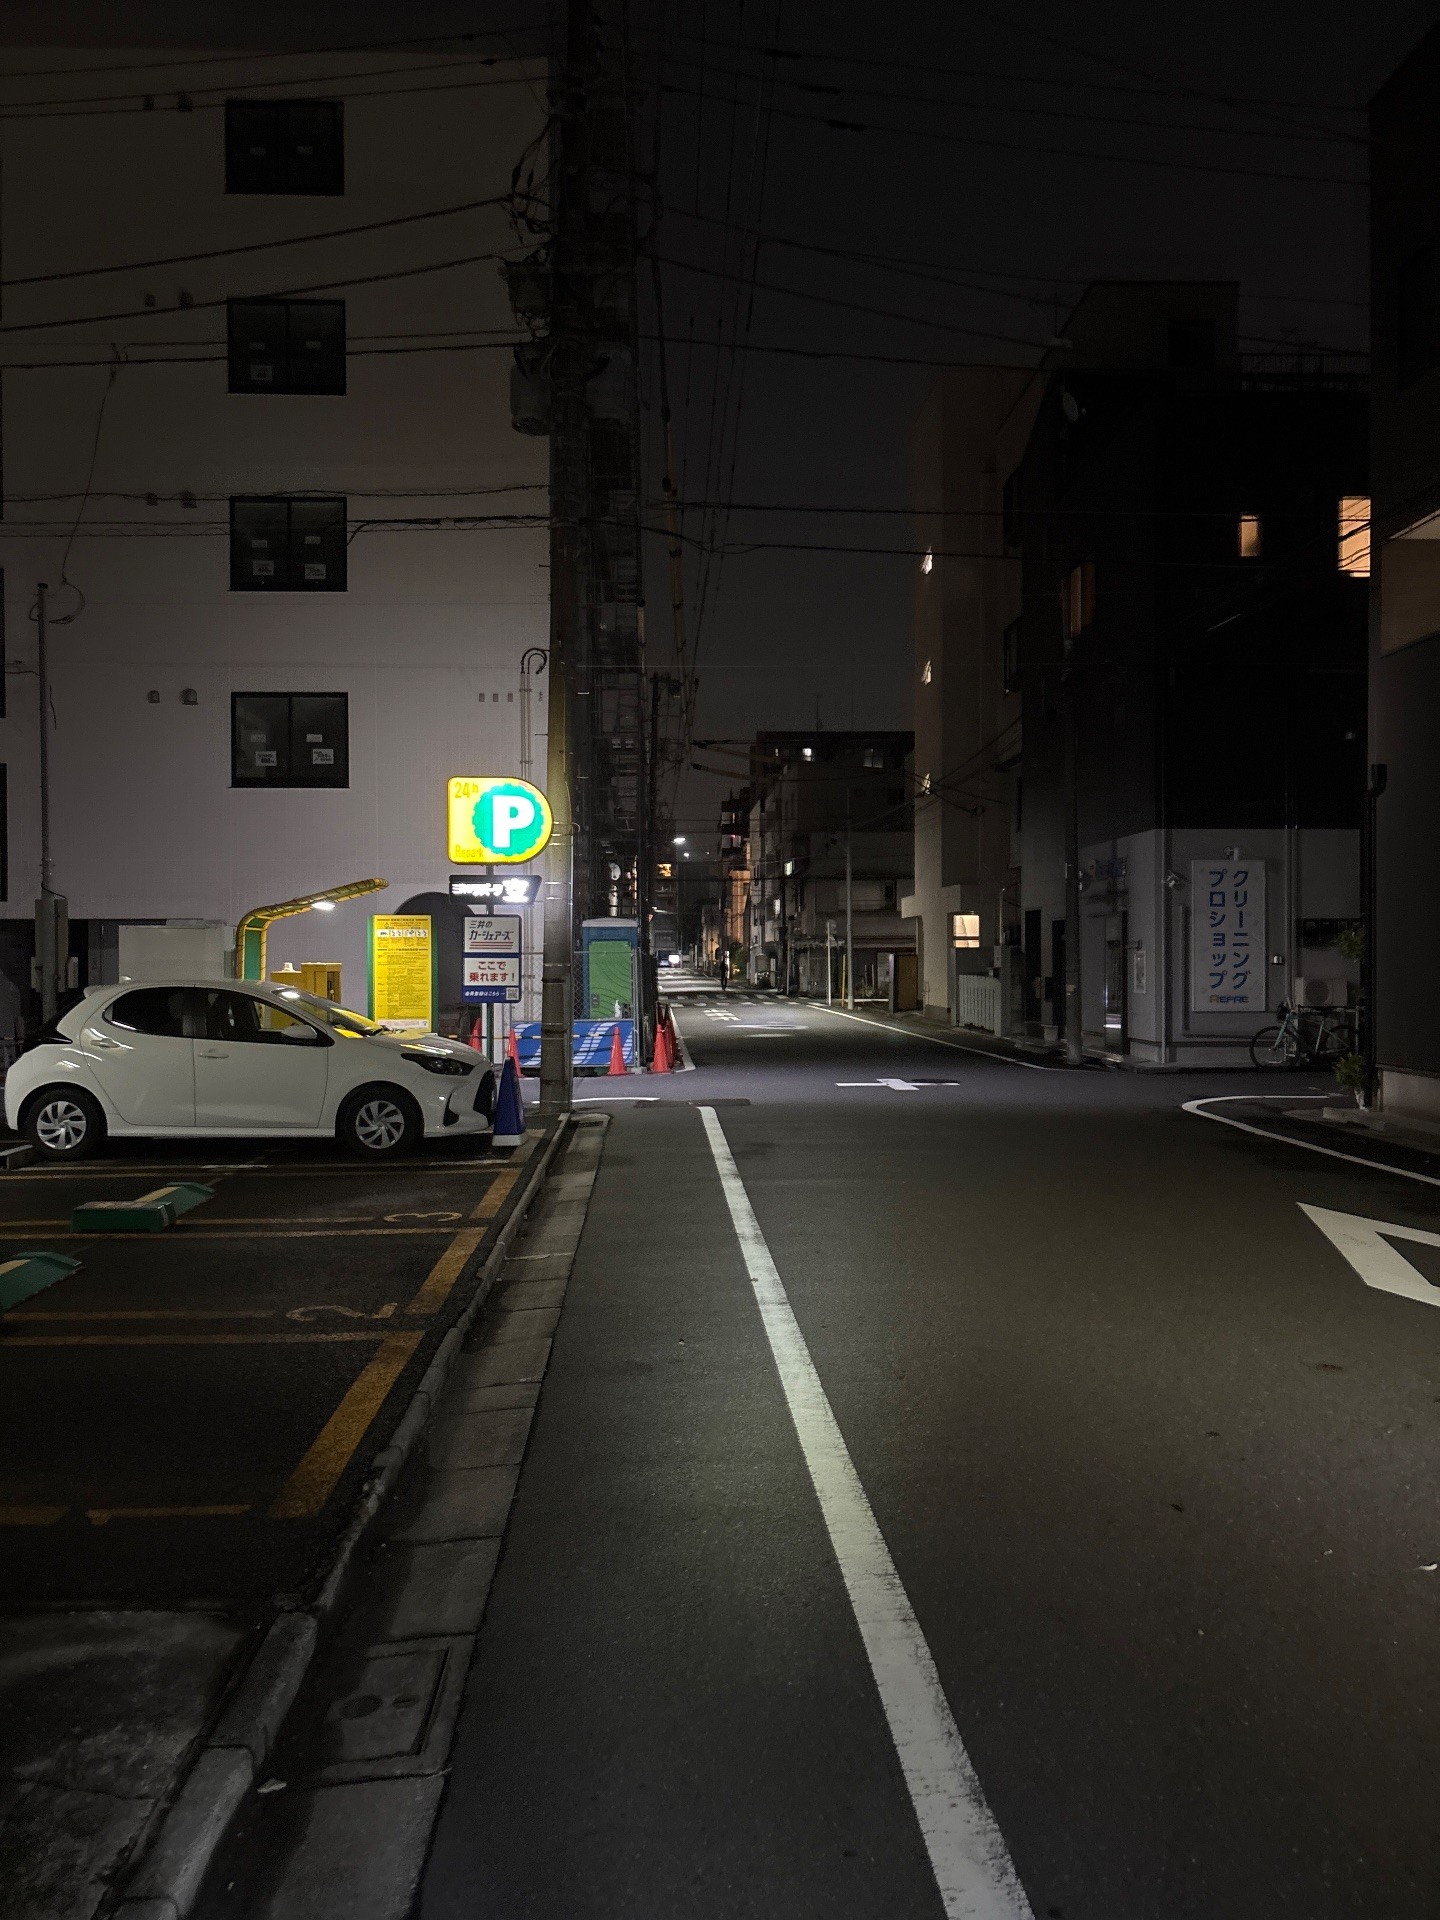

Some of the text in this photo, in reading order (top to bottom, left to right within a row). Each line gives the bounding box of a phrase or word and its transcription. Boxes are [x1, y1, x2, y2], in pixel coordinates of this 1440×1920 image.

[492, 794, 535, 848] P
[454, 845, 484, 858] Repark
[469, 920, 493, 929] 三井の
[1209, 869, 1228, 990] プロショップ
[1232, 869, 1251, 990] クリーニング
[469, 930, 515, 941] カーシェアーズ
[478, 961, 507, 971] ここで
